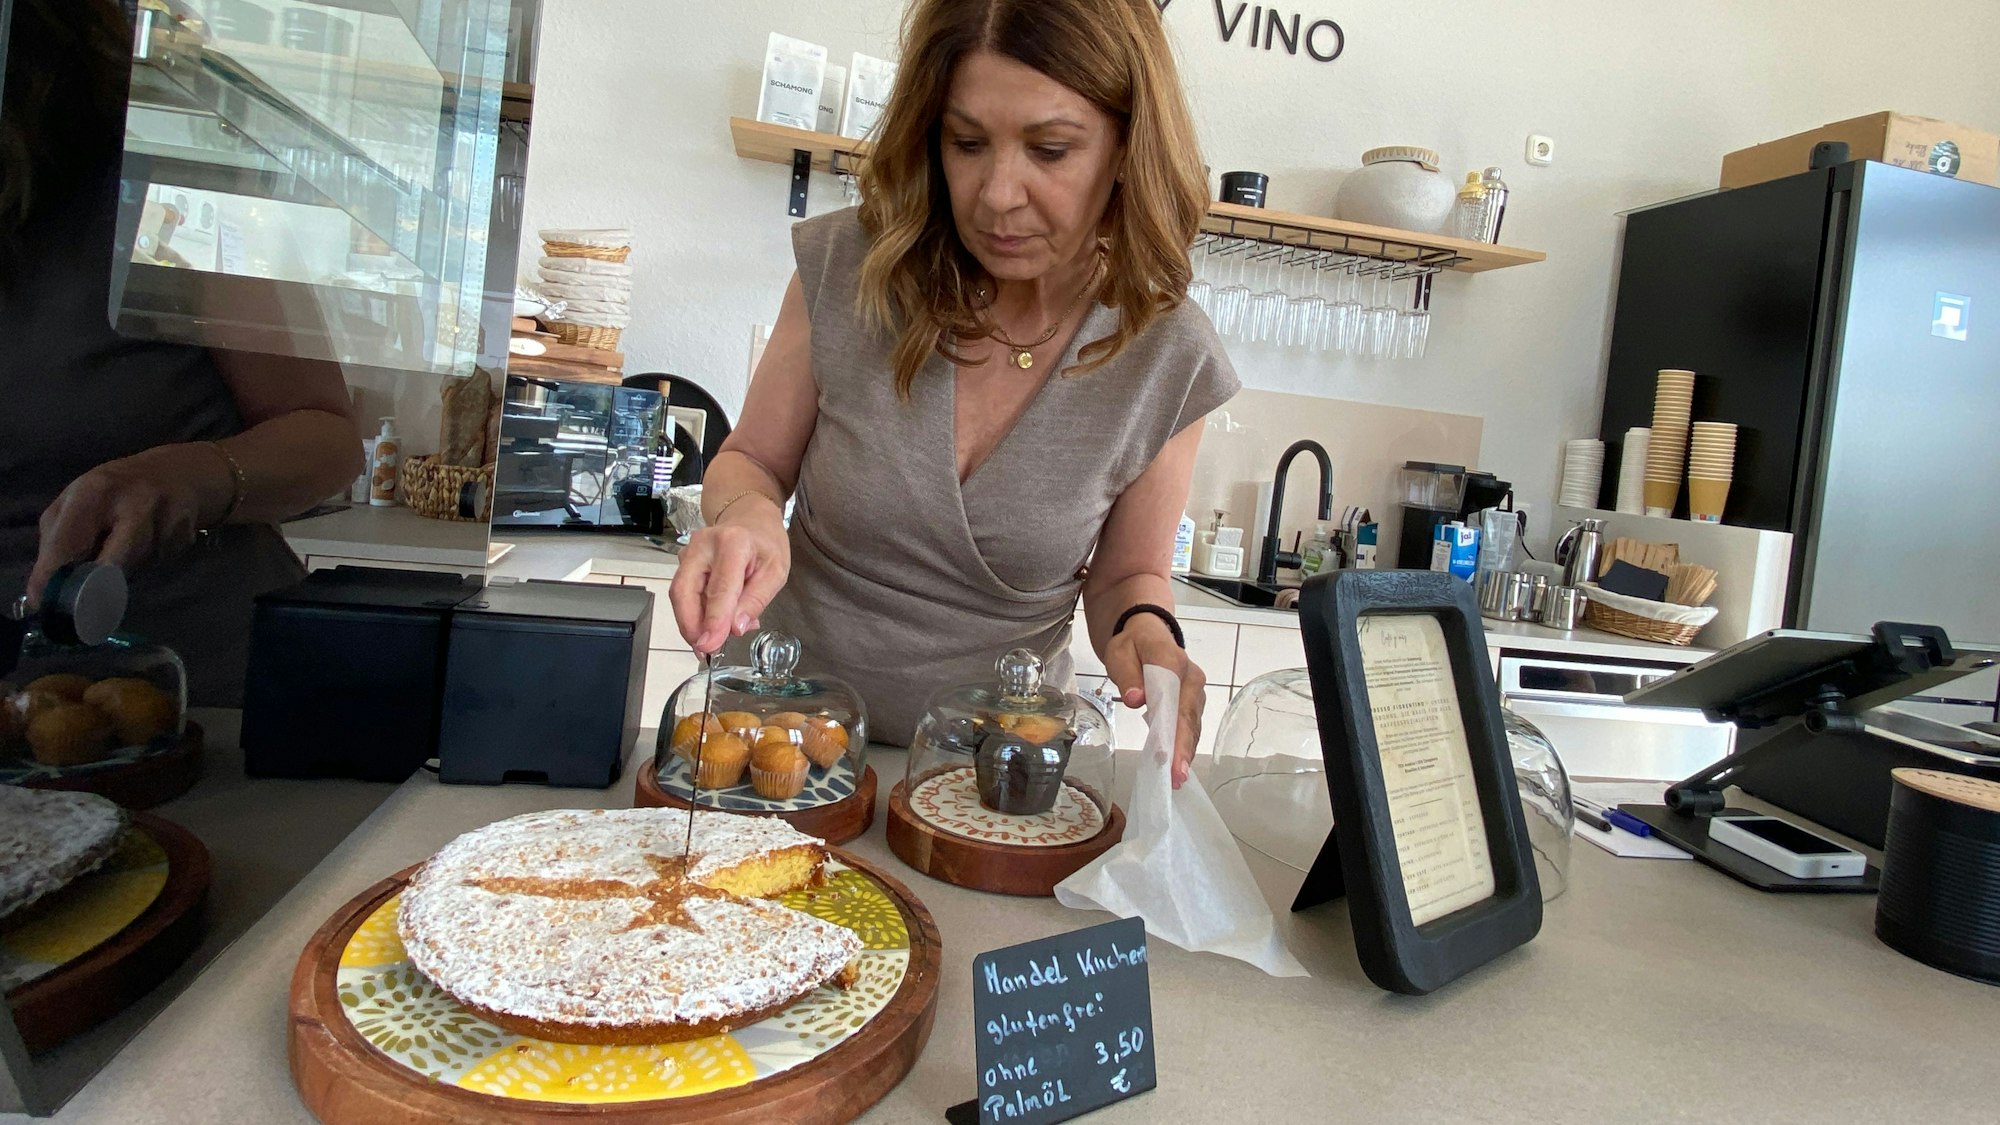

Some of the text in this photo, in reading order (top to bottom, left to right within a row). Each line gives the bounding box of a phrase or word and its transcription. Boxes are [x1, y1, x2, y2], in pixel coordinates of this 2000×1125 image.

[1214, 0, 1345, 62] VINO
[770, 79, 813, 96] SCHAMONG
[1076, 943, 1148, 978] Kuchen
[1095, 1026, 1145, 1065] 3,50
[985, 1057, 1038, 1087] ohne
[1110, 1068, 1131, 1094] €
